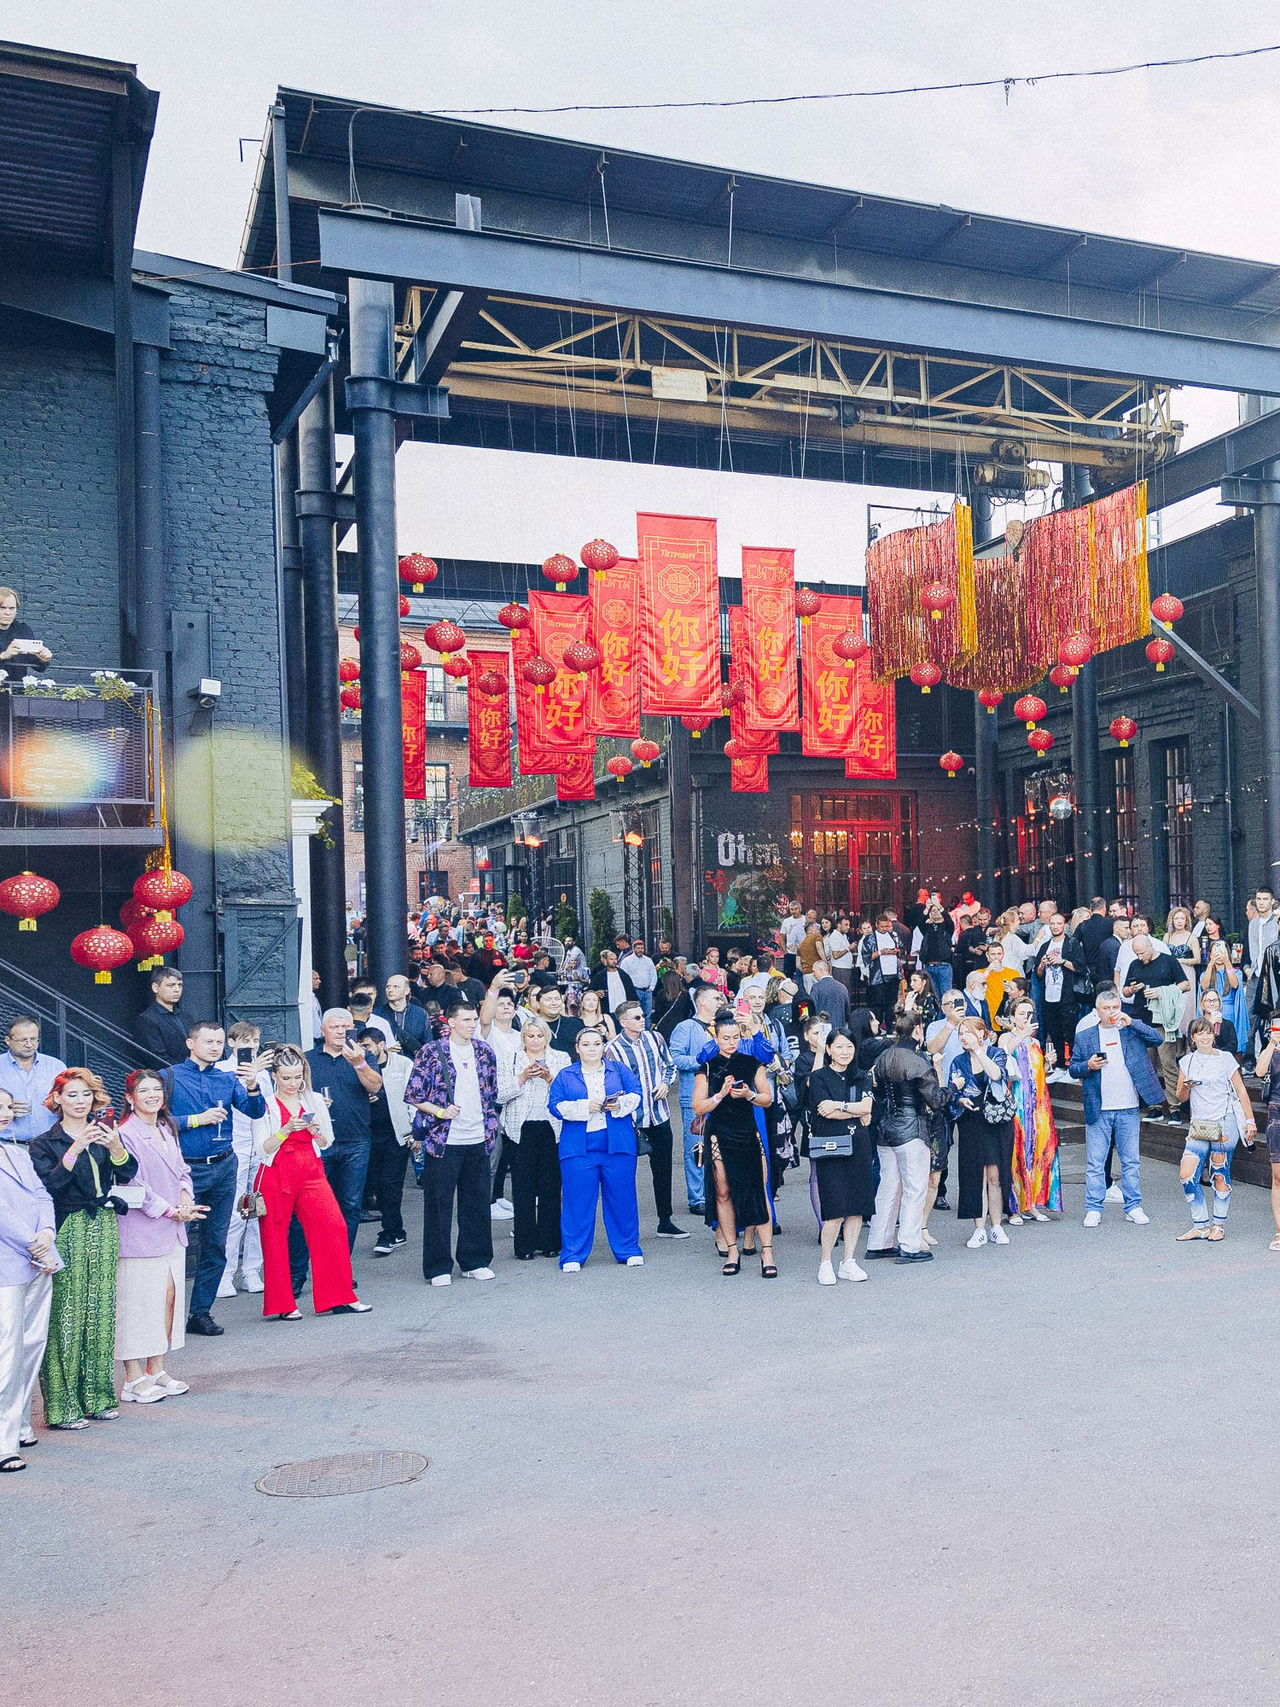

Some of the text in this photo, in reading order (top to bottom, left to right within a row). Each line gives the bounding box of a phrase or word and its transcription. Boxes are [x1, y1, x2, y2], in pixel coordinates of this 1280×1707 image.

[600, 630, 631, 687] 你好
[657, 608, 706, 687] 你好
[756, 625, 787, 683] 你好
[479, 708, 503, 749] 你好
[816, 670, 852, 734] 你好
